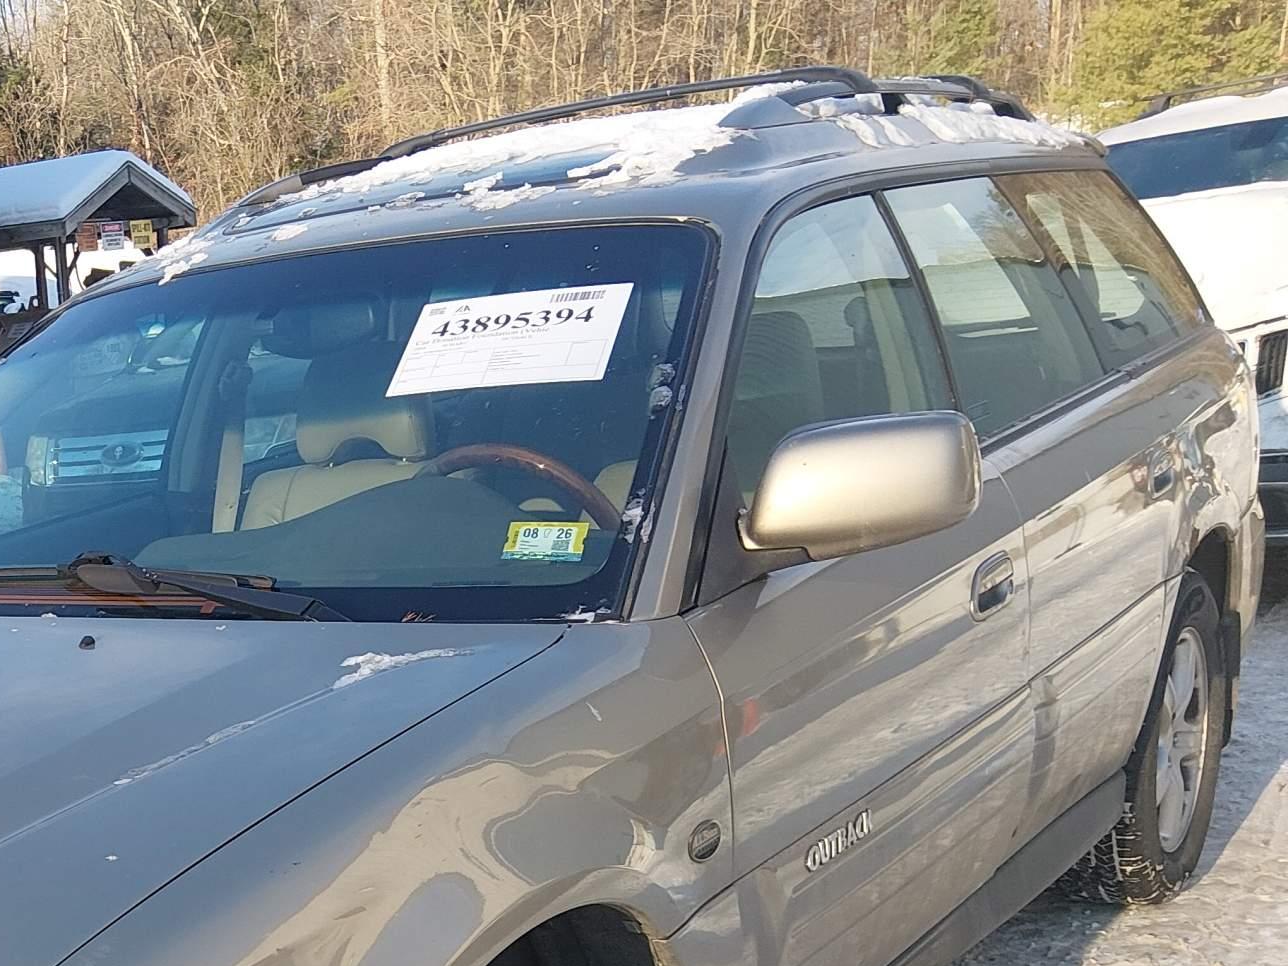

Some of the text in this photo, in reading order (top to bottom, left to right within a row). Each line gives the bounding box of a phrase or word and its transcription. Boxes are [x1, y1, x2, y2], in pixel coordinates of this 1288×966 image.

[432, 306, 595, 337] 43895394
[522, 527, 539, 539] 08
[556, 527, 573, 539] 26
[806, 808, 873, 872] OUTBACK
